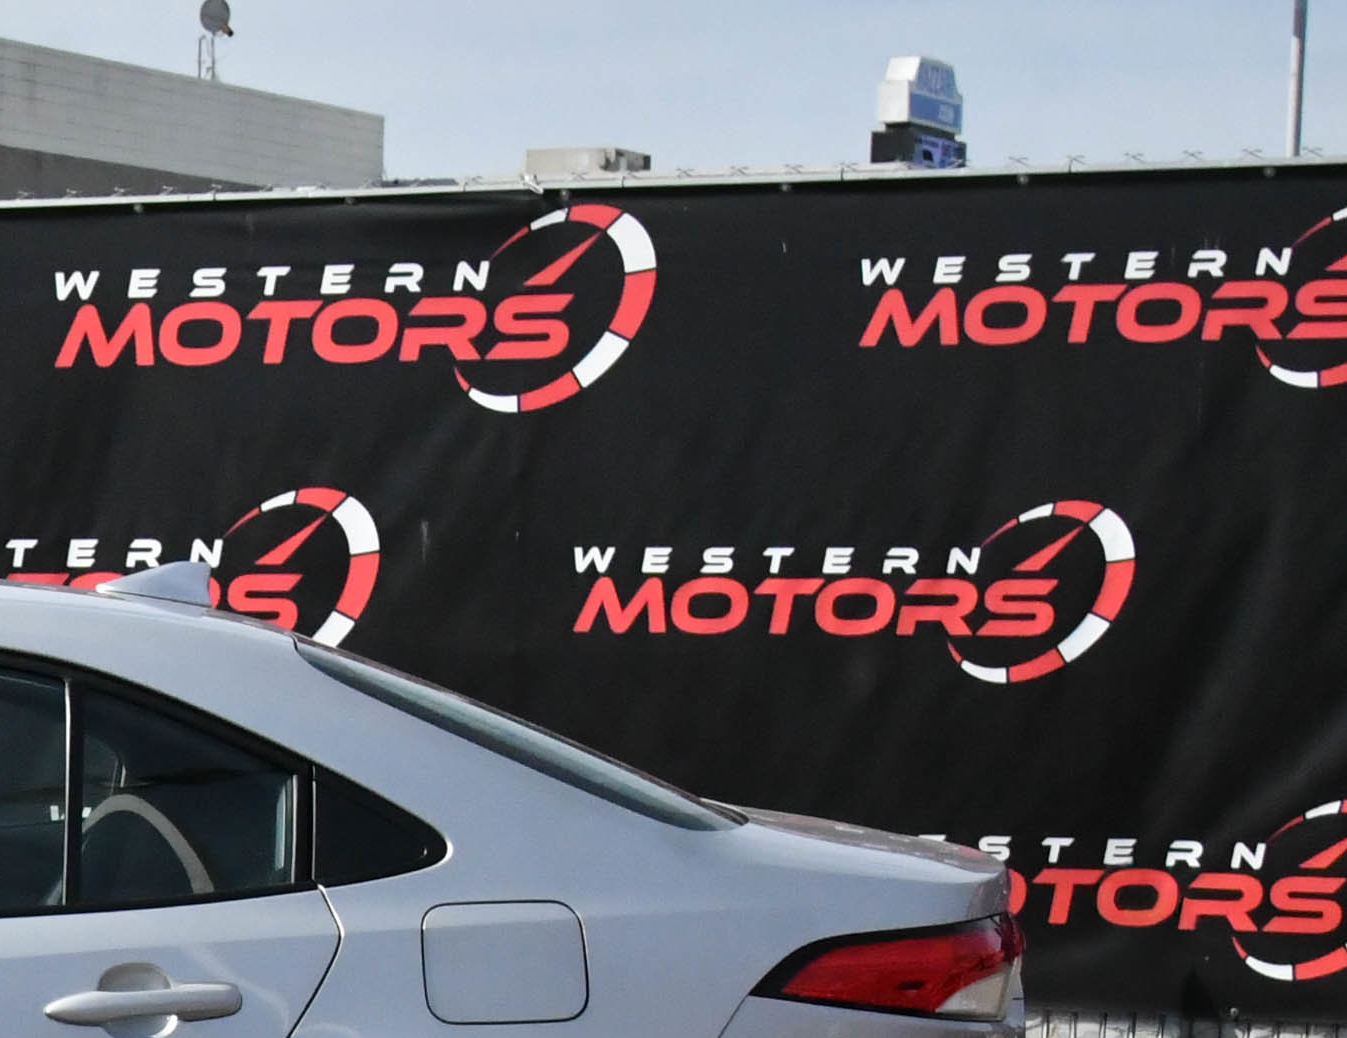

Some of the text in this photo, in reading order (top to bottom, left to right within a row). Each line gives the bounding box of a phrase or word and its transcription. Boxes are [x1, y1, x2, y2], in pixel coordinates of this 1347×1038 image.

[54, 260, 490, 302] WESTERN
[861, 247, 1293, 286] WESTERN
[54, 292, 575, 369] MOTORS
[859, 278, 1347, 348] MOTORS
[573, 546, 981, 575] WESTERN
[573, 575, 1059, 637] MOTORS
[918, 833, 1267, 870] STERN
[1008, 866, 1346, 934] TORS
